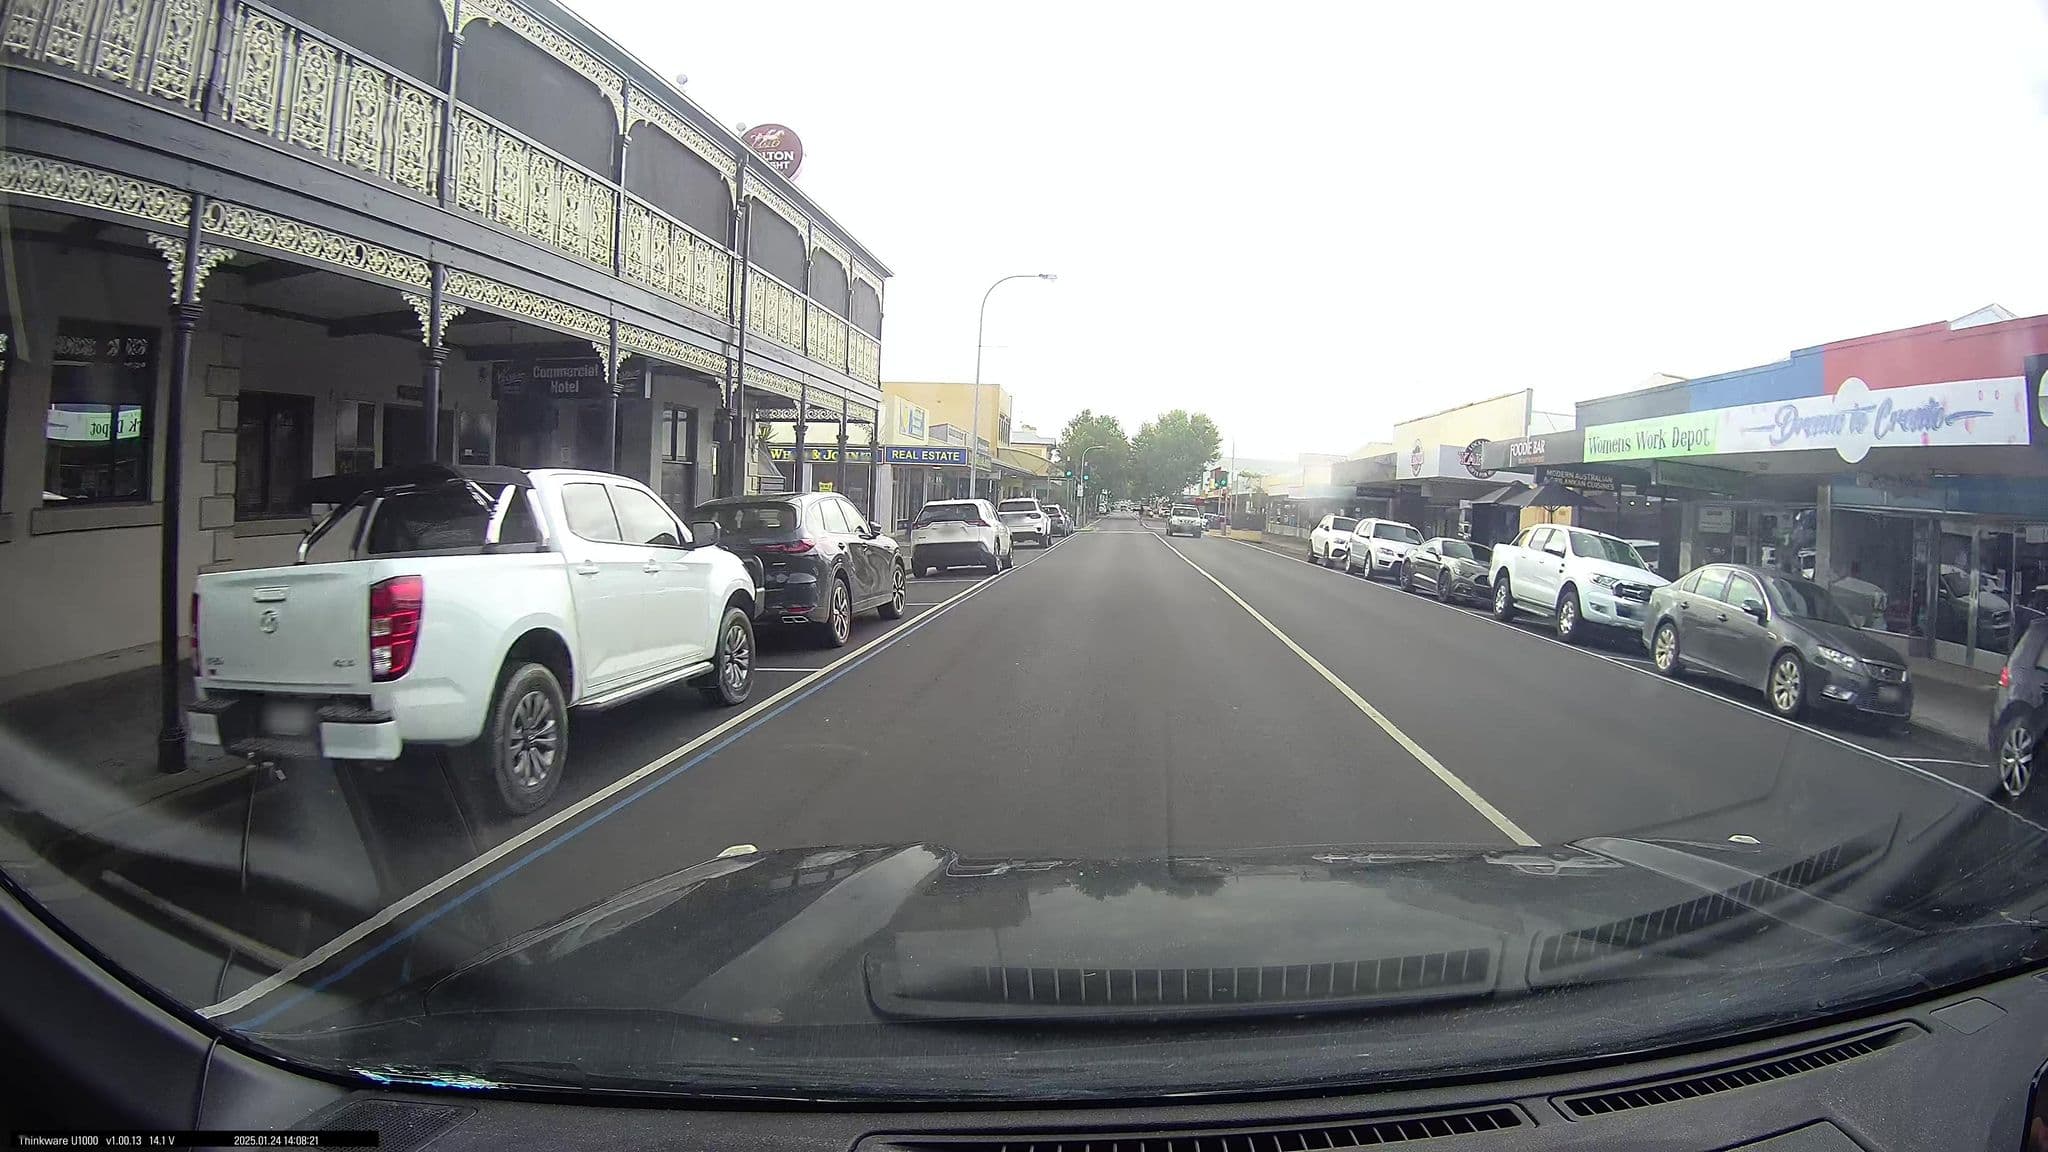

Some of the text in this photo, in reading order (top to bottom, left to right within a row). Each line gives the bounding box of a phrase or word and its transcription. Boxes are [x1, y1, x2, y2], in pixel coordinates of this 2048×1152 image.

[533, 364, 599, 378] Commercial
[551, 380, 580, 393] Hotel
[1533, 440, 1546, 455] BAR
[1588, 426, 1711, 455] Womens Work Depot
[892, 450, 960, 461] REAL ESTATE
